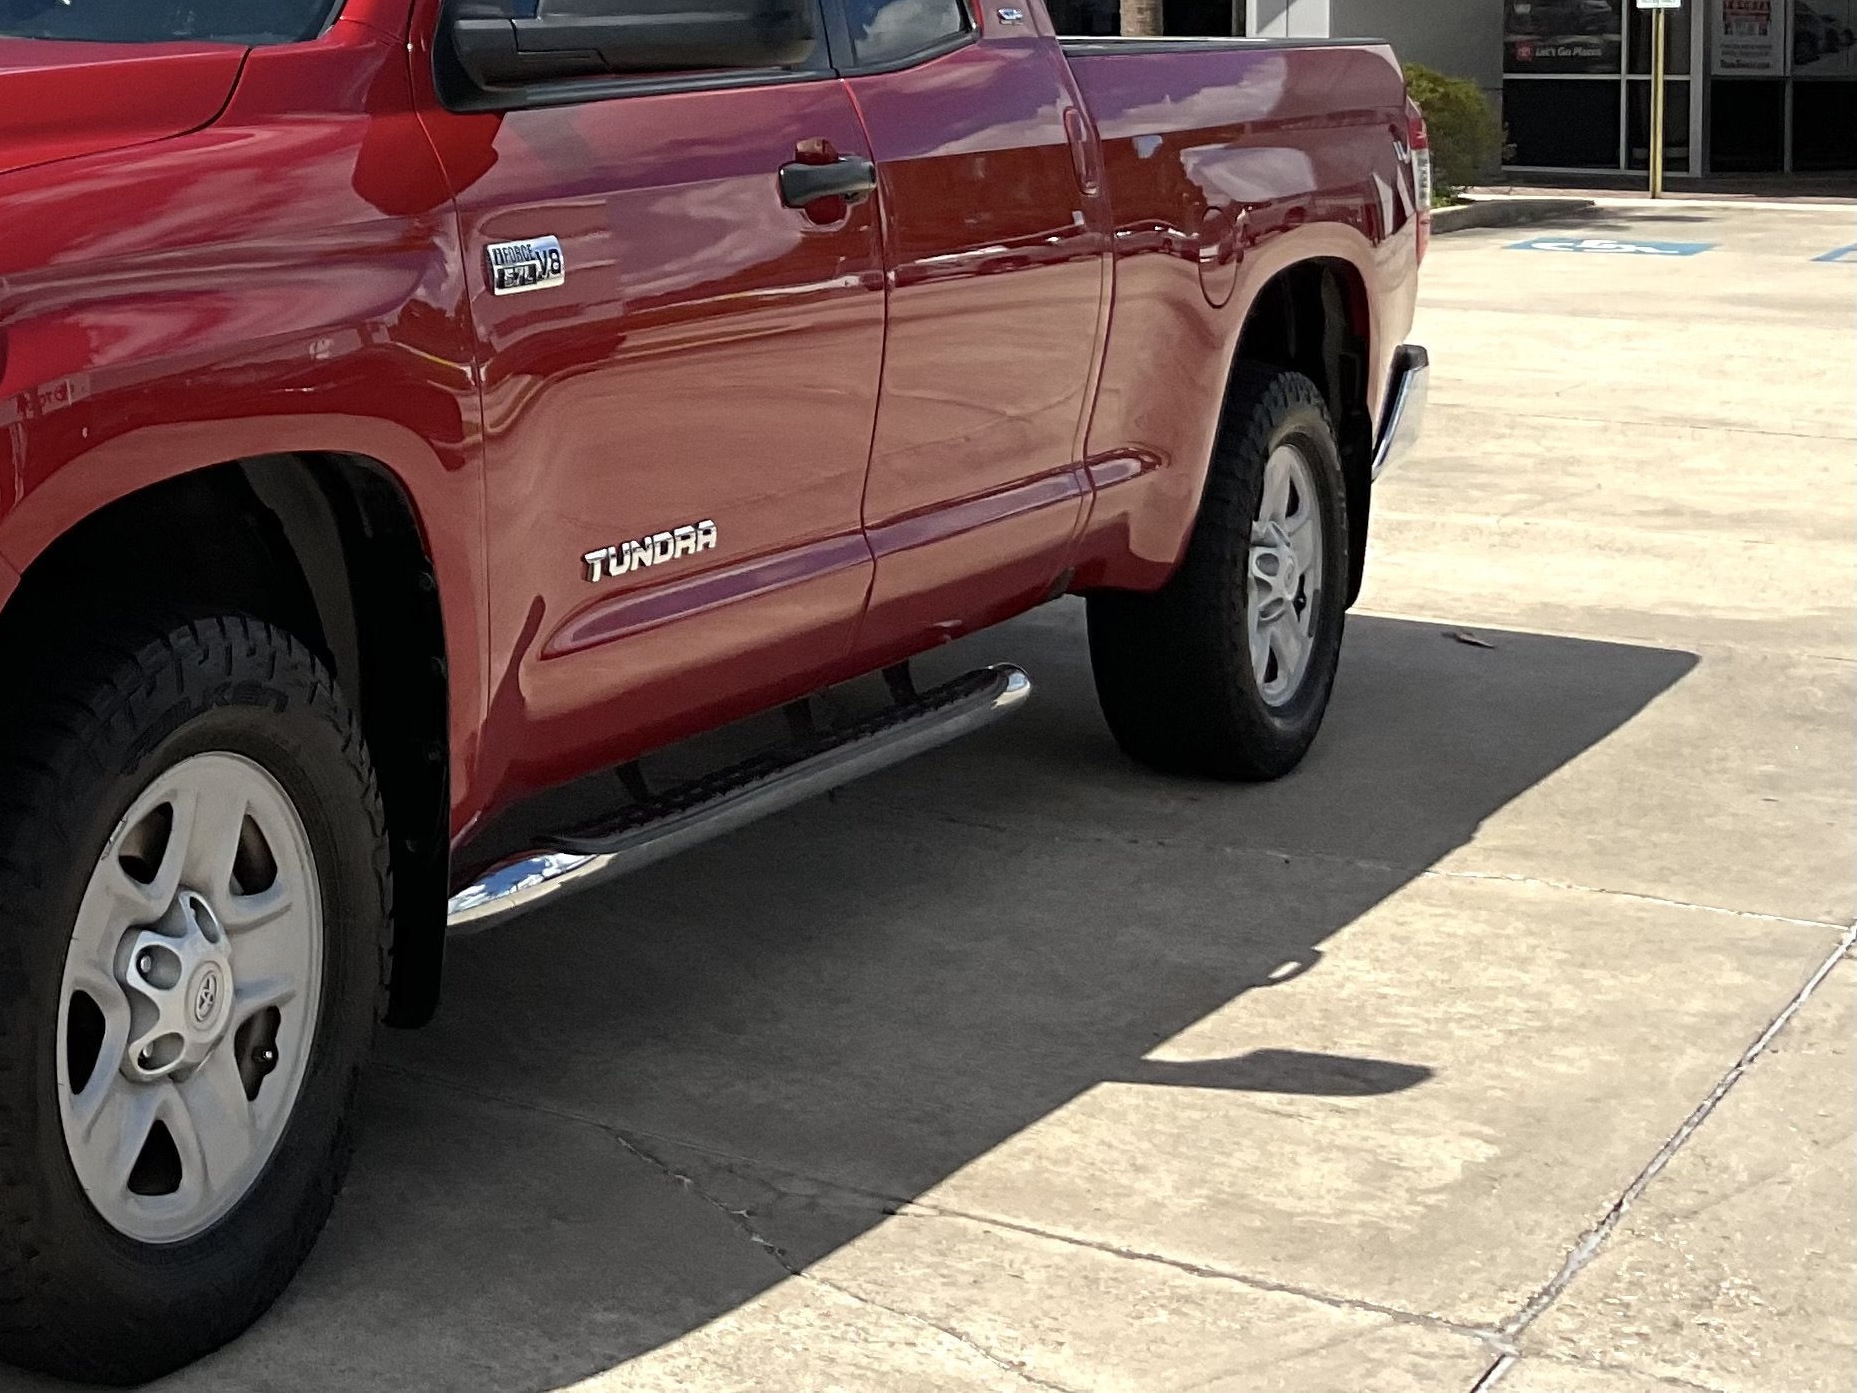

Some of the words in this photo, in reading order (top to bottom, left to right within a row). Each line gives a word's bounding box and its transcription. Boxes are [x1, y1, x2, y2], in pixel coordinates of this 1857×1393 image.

[1557, 46, 1572, 57] Go
[536, 248, 562, 276] V8
[584, 519, 717, 583] TUNDRA
